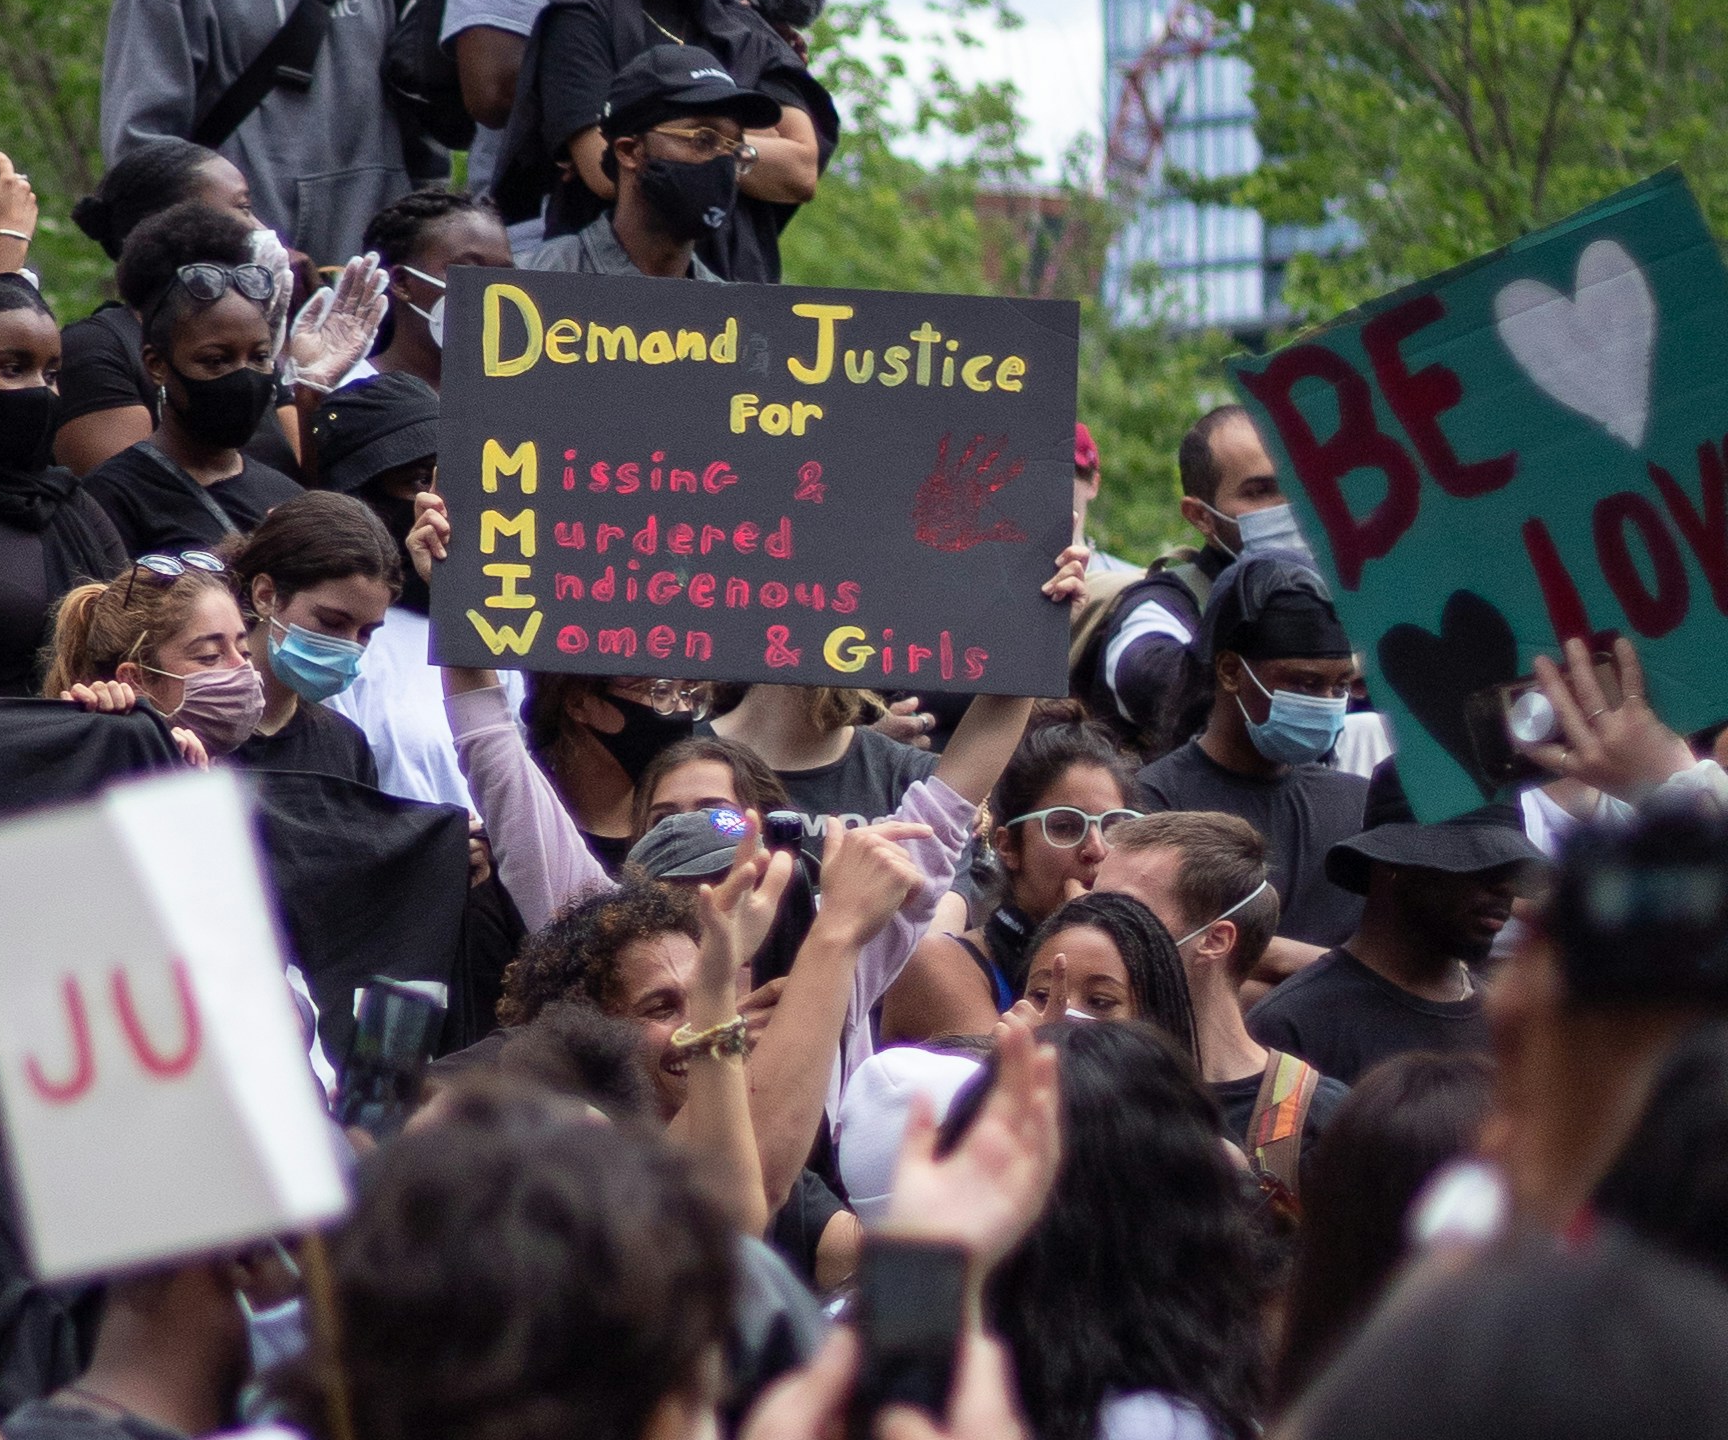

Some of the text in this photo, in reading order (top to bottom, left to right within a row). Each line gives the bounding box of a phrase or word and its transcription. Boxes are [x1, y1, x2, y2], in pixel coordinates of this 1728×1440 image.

[483, 284, 1028, 393] Demand Justice
[730, 394, 823, 435] For
[1237, 294, 1520, 591] BE
[794, 461, 827, 504] &
[480, 508, 793, 559] Murdered
[466, 609, 990, 681] Women & Girls
